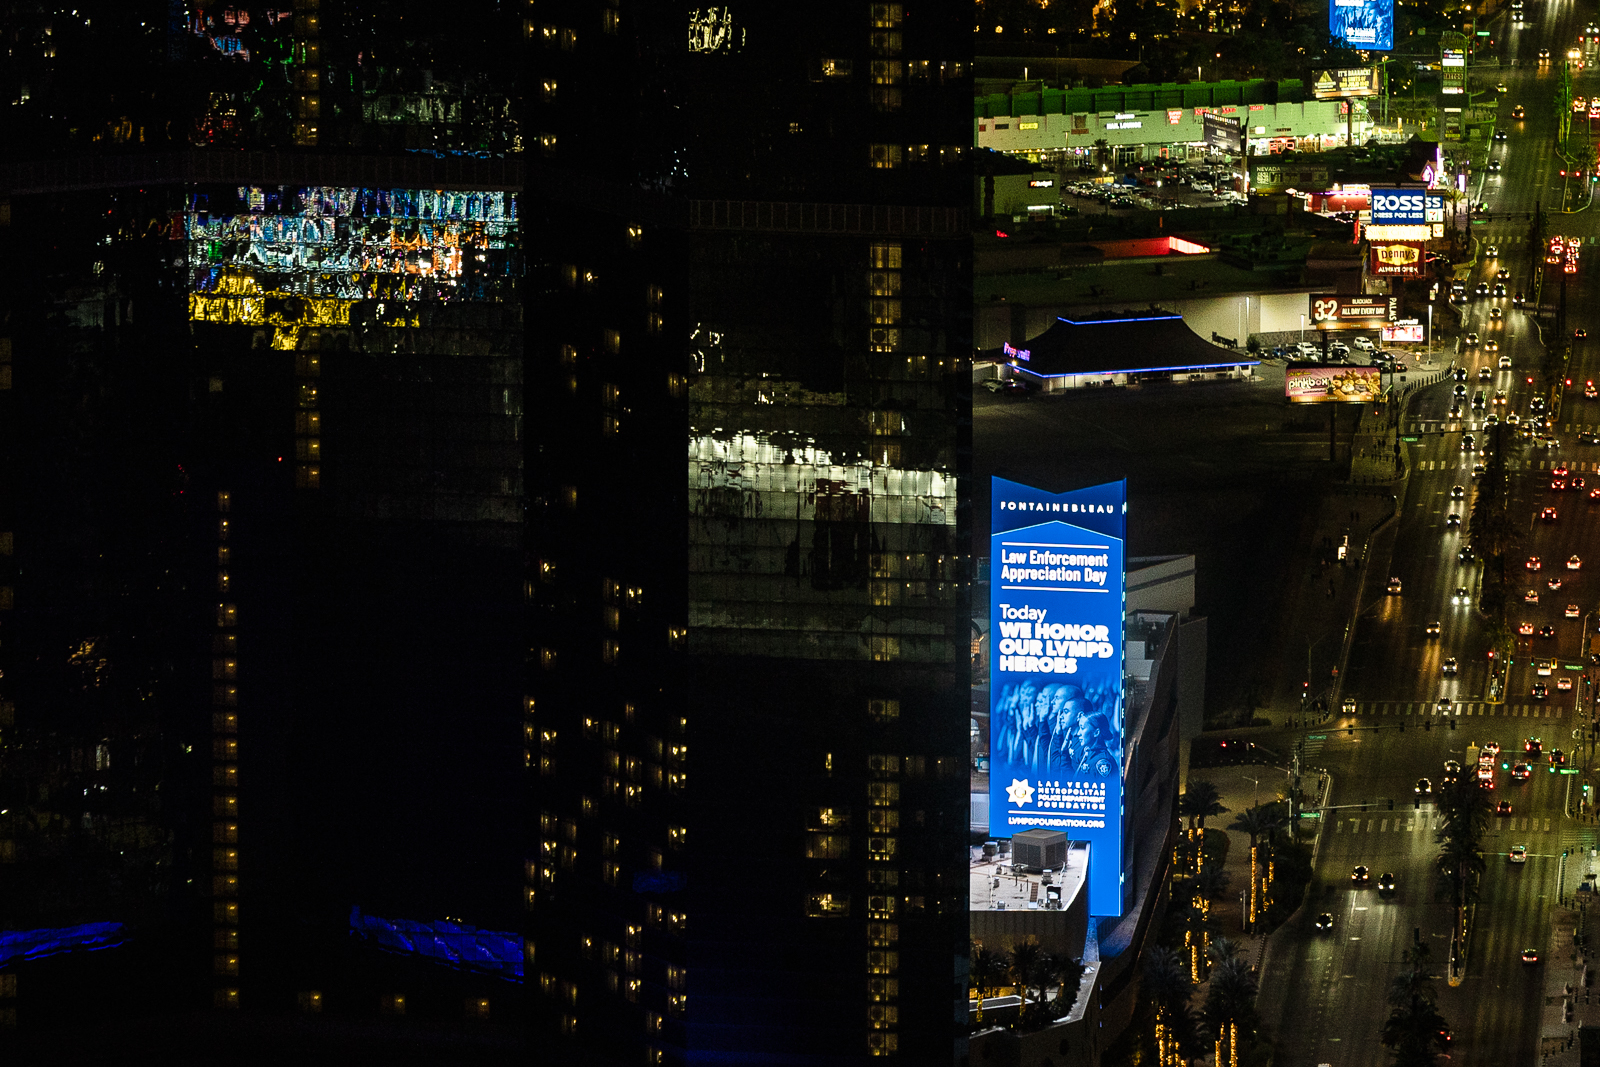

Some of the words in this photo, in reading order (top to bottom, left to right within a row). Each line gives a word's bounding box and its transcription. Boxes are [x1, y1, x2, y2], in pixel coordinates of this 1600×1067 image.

[1373, 195, 1424, 211] ROSS
[1425, 196, 1441, 208] SS
[1381, 249, 1416, 261] Denny's
[1314, 299, 1338, 321] 3:2
[1375, 307, 1385, 315] DAY
[1388, 297, 1398, 321] PALMS
[1288, 376, 1328, 390] pinkbox
[1000, 501, 1114, 514] FONTAINEBLEAU
[1001, 549, 1027, 564] Law
[1029, 550, 1109, 567] Enforcement
[1001, 564, 1081, 583] Appreciation
[1084, 567, 1107, 586] Day
[999, 603, 1047, 624] Today
[999, 621, 1032, 639] WE
[1034, 622, 1109, 641] HONOR
[999, 638, 1043, 656] OUR
[1045, 639, 1114, 658] LVMPD
[999, 655, 1077, 674] HEROES
[1037, 787, 1105, 796] METROPOLITAN
[1066, 781, 1105, 789] VEGAS
[1037, 801, 1105, 810] FOUNDATION
